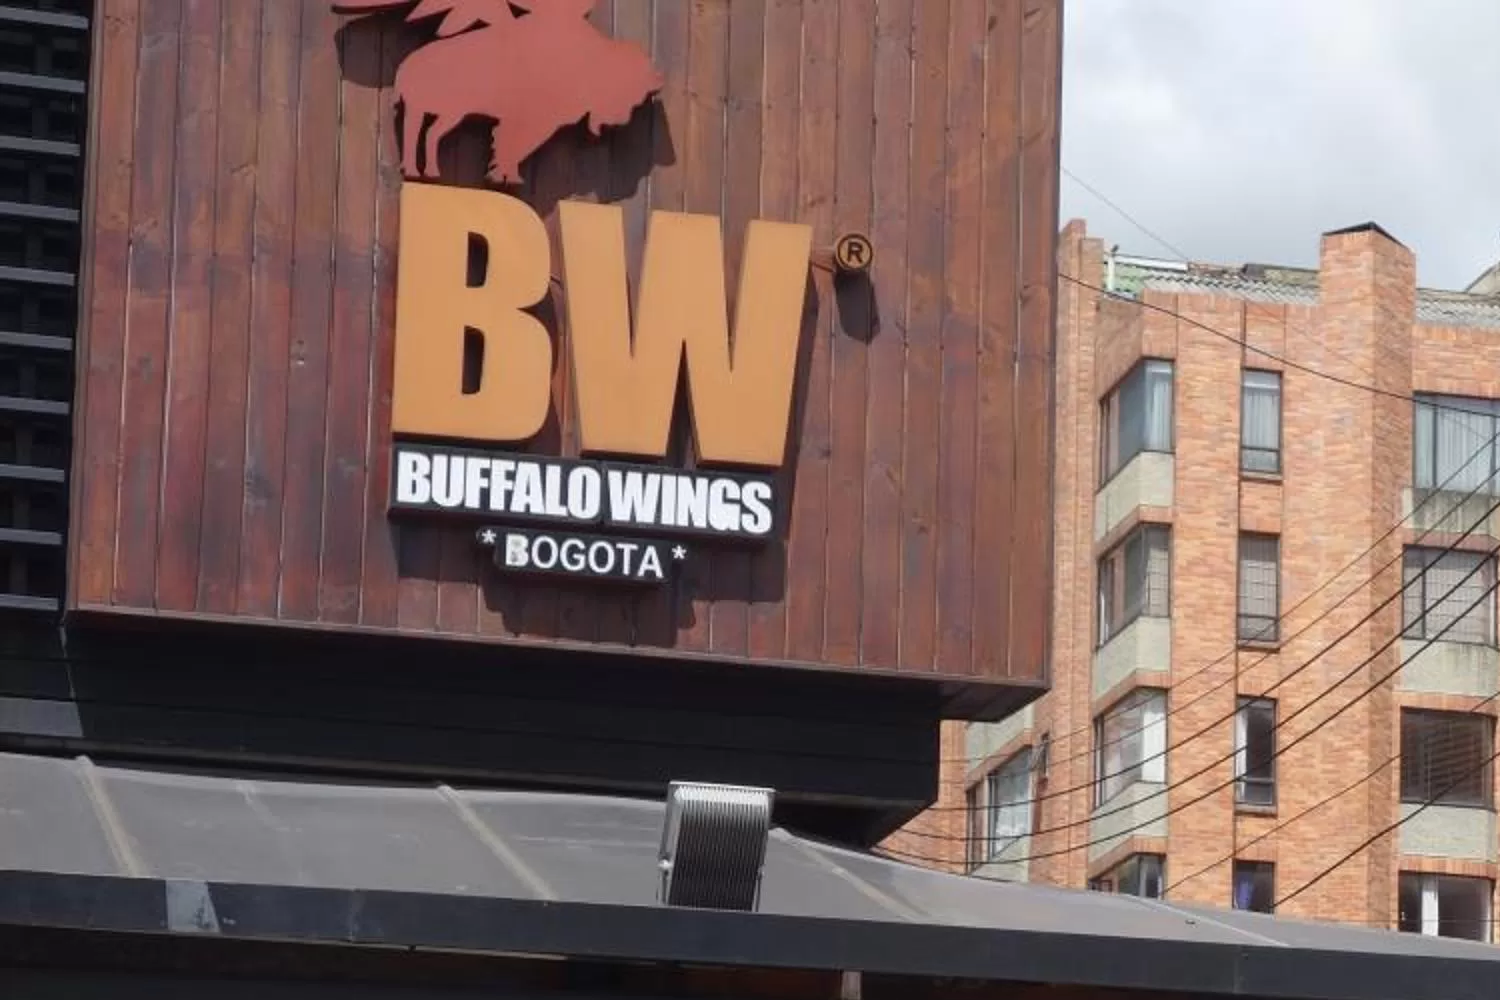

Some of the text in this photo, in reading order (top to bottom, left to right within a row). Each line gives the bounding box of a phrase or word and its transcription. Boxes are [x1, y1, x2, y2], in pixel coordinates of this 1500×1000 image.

[392, 181, 812, 466] BW
[397, 450, 773, 533] BUFFALO WINGS
